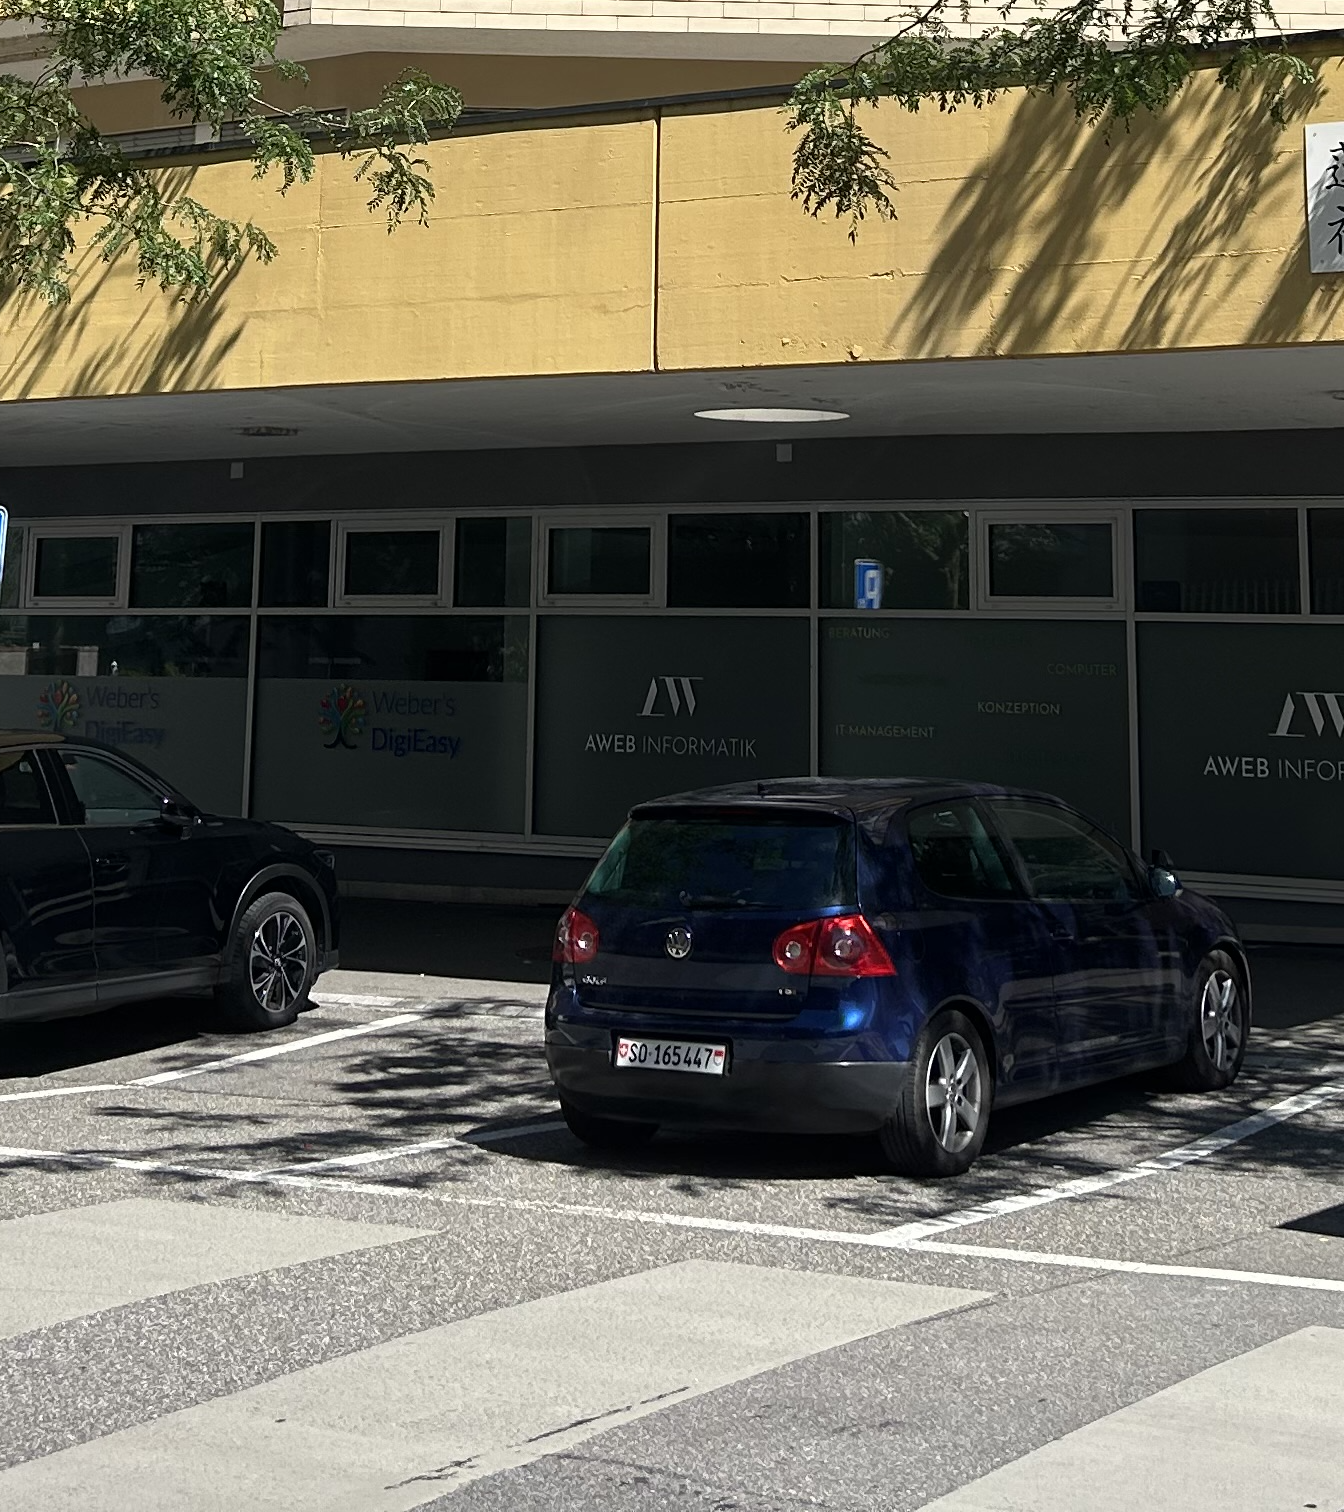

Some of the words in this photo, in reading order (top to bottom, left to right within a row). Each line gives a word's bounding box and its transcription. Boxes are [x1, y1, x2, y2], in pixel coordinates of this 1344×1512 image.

[829, 626, 891, 639] BERATUNG
[1046, 663, 1118, 677] COMPUTER
[86, 686, 160, 710] Weber's
[371, 690, 456, 717] Weber's
[976, 701, 1062, 716] KONZEPTION
[84, 720, 166, 747] DigiEasy
[835, 724, 845, 737] IT
[848, 724, 936, 739] MANAGEMENT
[370, 727, 462, 760] DigiEasy
[584, 734, 636, 753] AWEB
[642, 735, 757, 758] INFORMATIK
[1203, 756, 1270, 779] AWEB
